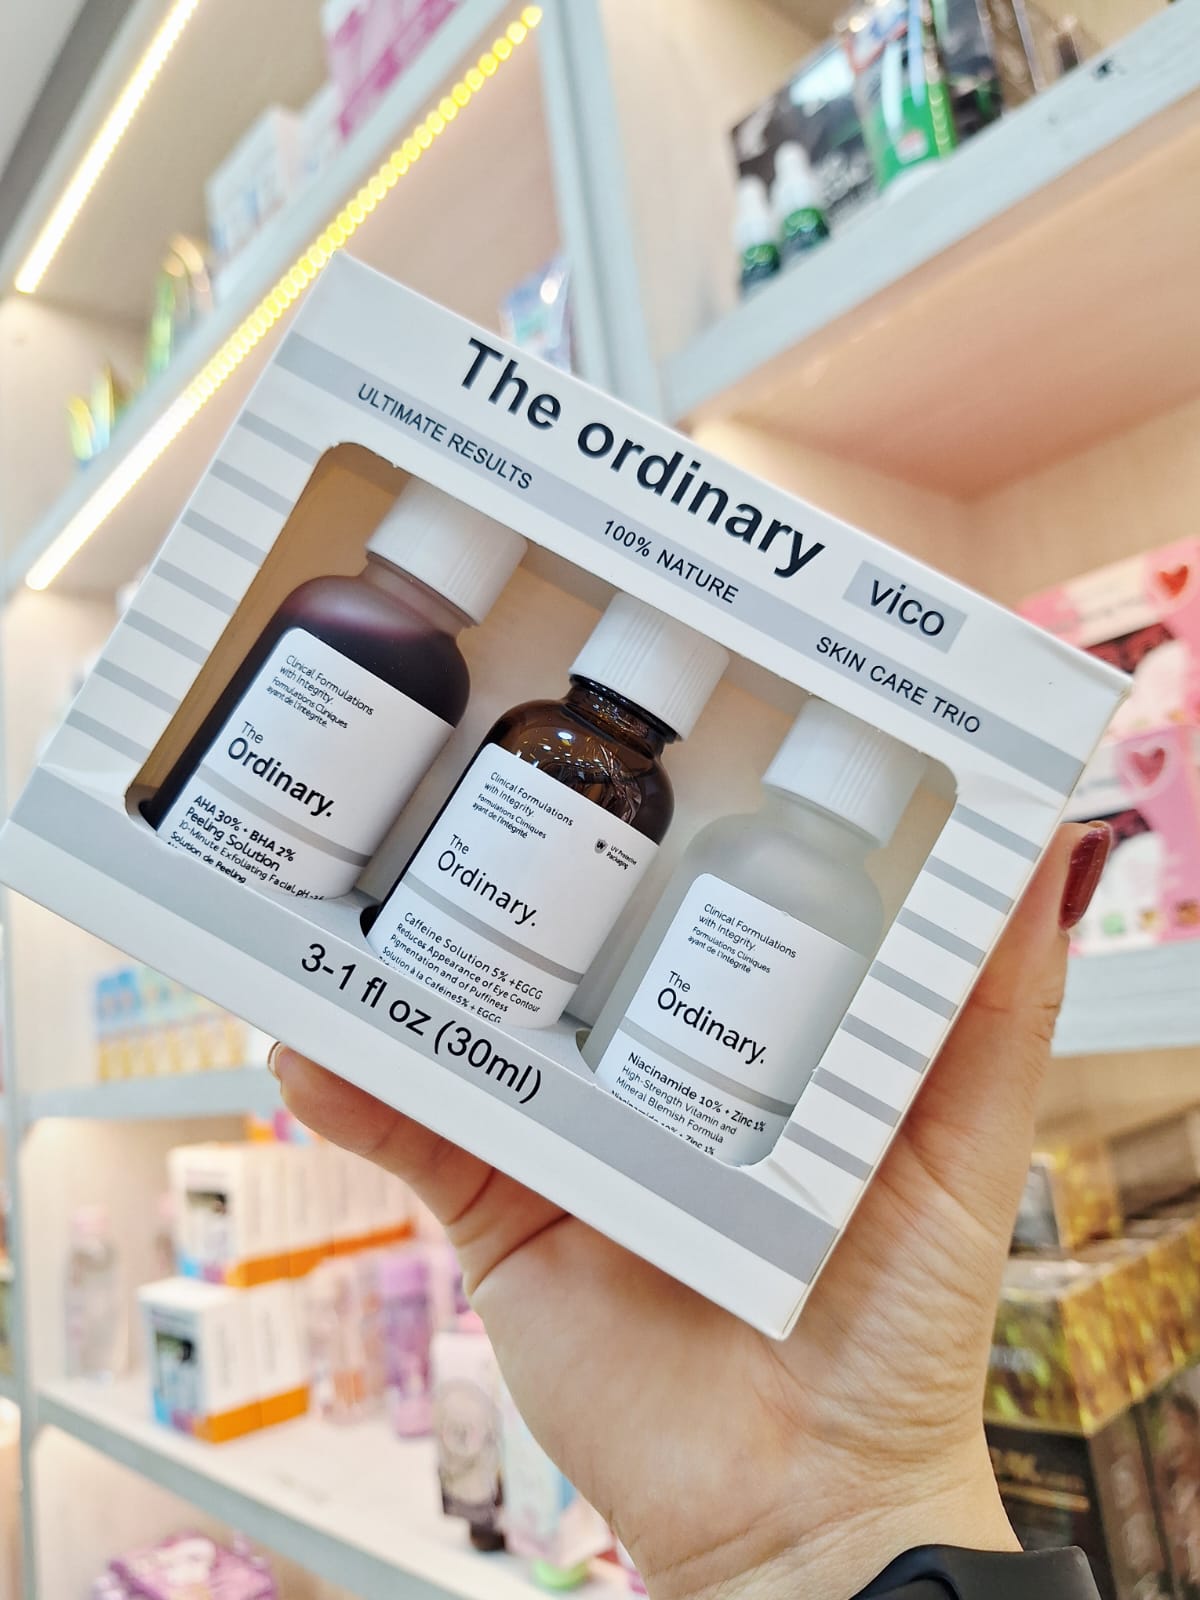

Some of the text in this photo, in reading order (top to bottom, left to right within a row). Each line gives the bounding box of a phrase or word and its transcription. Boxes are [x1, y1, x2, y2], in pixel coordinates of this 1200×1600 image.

[358, 383, 532, 489] ULTIMATE RESULTS
[461, 337, 826, 578] The ordinary
[605, 520, 739, 604] 100% NATURE
[871, 580, 944, 636] vico
[272, 676, 315, 708] Formulations
[280, 666, 296, 680] with
[286, 655, 374, 715] Clinical Formulations
[816, 637, 980, 733] SKIN CARE TRIO
[242, 721, 263, 744] The
[228, 737, 334, 817] Ordinary.
[484, 783, 499, 795] with
[490, 772, 573, 826] Clinical Formulations
[186, 806, 280, 871] Peeling Solution
[193, 795, 216, 816] AHA
[214, 810, 242, 831] 30%
[249, 830, 275, 852] BHA
[276, 846, 296, 862] 2%
[472, 802, 489, 815] ayant
[488, 812, 497, 820] de
[478, 793, 546, 839] Formulations Cliniques
[170, 831, 202, 857] Solution
[203, 855, 214, 864] de
[215, 861, 247, 883] Peeling
[179, 820, 220, 852] 10-Minute
[220, 847, 268, 881] Exfoliating
[450, 834, 469, 855] The
[438, 850, 537, 927] Ordinary.
[688, 936, 706, 949] ayant
[706, 946, 716, 955] de
[693, 926, 770, 973] Formulations Cliniques
[699, 915, 716, 929] with
[704, 904, 796, 958] Clinical Formulations
[382, 946, 410, 971] Solution
[390, 934, 440, 973] Pigmentation
[440, 970, 459, 984] and
[458, 981, 470, 990] of
[469, 986, 508, 1012] Puffiness
[405, 912, 543, 1000] Caffeine Solution 5% +EGCG
[427, 946, 481, 983] Appearance
[482, 980, 494, 989] of
[493, 984, 509, 998] Eye
[510, 993, 540, 1012] Contour
[669, 970, 690, 992] The
[301, 943, 356, 990] 3-1
[361, 977, 388, 1008] fl
[389, 1000, 432, 1036] oz
[434, 1020, 541, 1104] (30ml)
[658, 988, 766, 1065] Ordinary.
[616, 1076, 647, 1102] Mineral
[648, 1097, 685, 1124] Blemish
[687, 1119, 724, 1143] Formula
[622, 1065, 683, 1108] High-Strength
[685, 1103, 719, 1127] Vitamin
[720, 1124, 737, 1135] and
[628, 1052, 697, 1100] Niacinamide
[699, 1096, 723, 1113] 10%
[731, 1110, 753, 1127] Zinc
[753, 1121, 766, 1132] 1%
